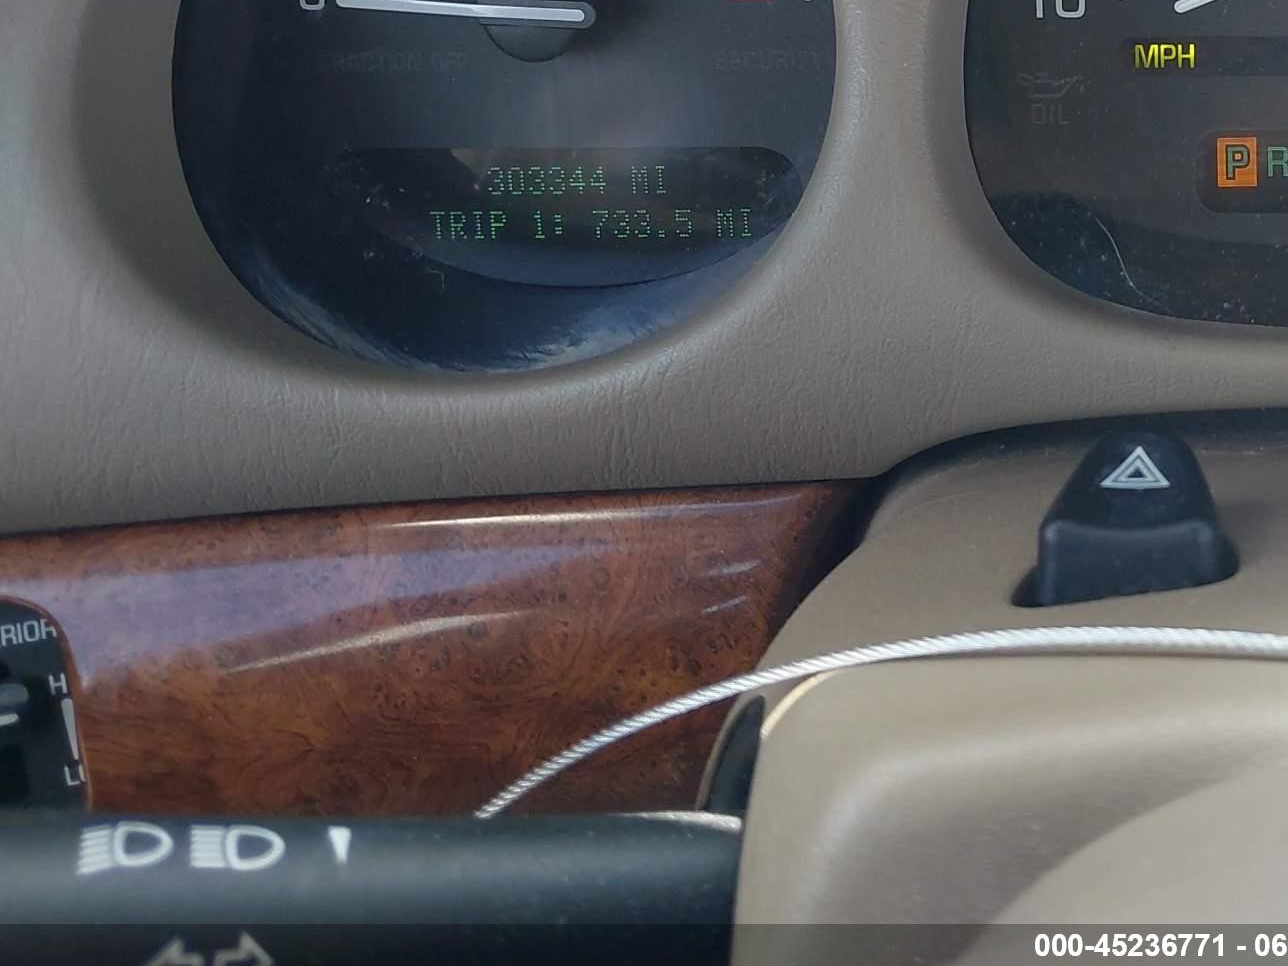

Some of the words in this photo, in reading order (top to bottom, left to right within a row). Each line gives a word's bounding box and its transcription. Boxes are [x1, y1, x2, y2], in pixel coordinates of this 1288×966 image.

[1136, 44, 1194, 67] MPH
[1031, 103, 1071, 125] OIL
[1225, 144, 1250, 180] P
[1267, 146, 1288, 177] R
[488, 167, 606, 194] 303344
[631, 166, 665, 193] MI
[430, 212, 506, 239] TRIP
[534, 211, 562, 238] 1:
[593, 210, 691, 237] 733.5
[717, 209, 751, 236] MI
[48, 673, 68, 696] H
